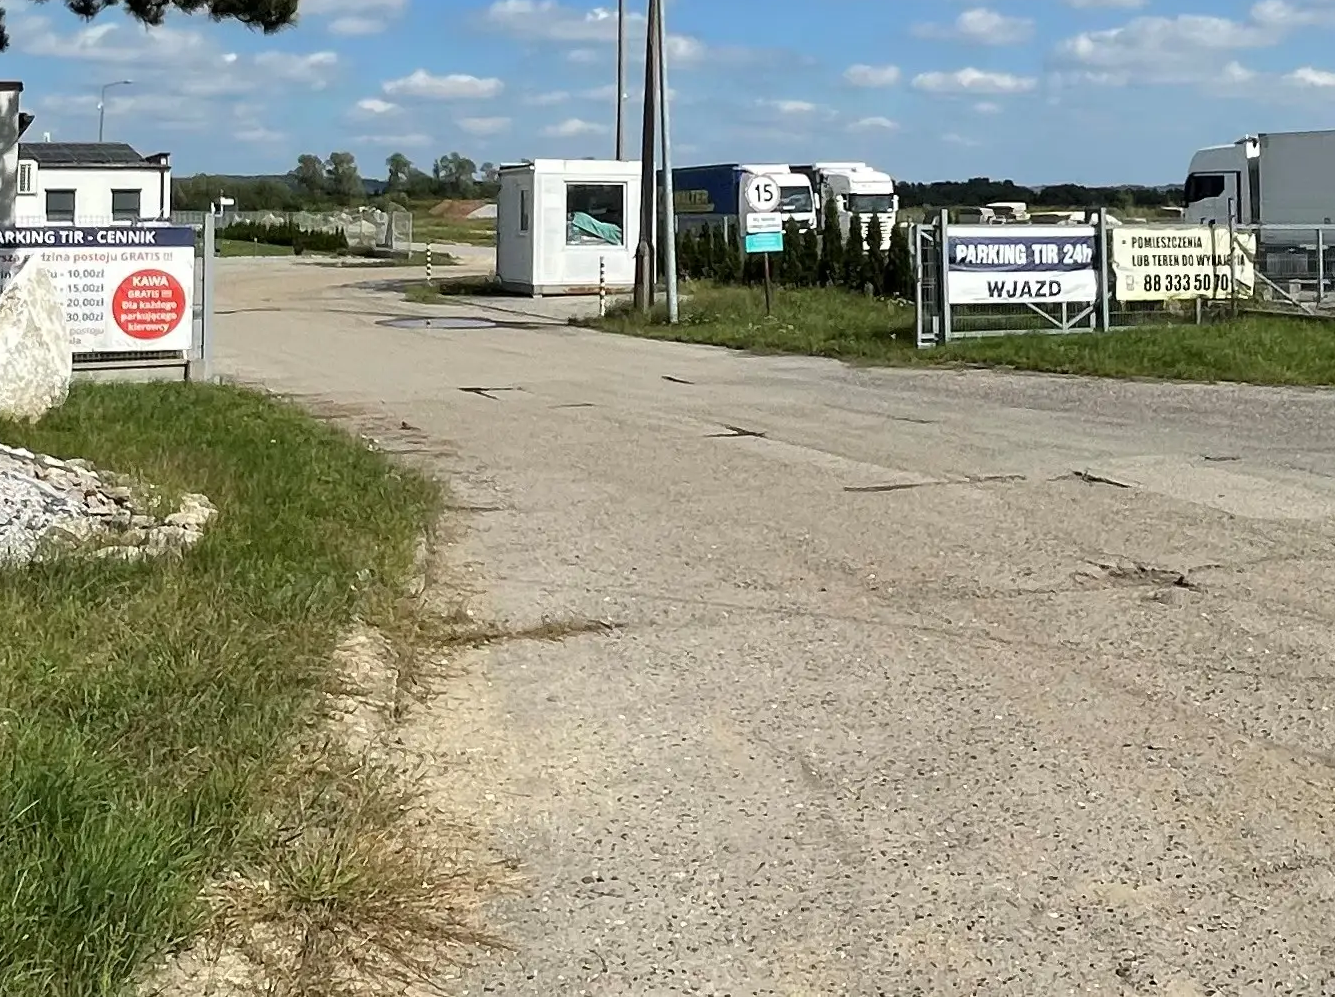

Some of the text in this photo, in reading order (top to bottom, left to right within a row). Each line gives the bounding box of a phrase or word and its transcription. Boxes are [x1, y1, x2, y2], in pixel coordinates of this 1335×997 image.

[754, 184, 773, 202] 15
[59, 230, 84, 244] TIR
[96, 230, 156, 244] CENNIK
[1131, 236, 1202, 249] POMIESZCZENIA
[73, 252, 117, 263] postoju
[121, 252, 160, 262] GRATIS
[956, 243, 1092, 264] PARKING TIR 24h
[1132, 254, 1150, 267] LUB
[1152, 254, 1180, 267] TEREN
[1182, 254, 1194, 267] DO
[133, 276, 169, 286] KAWA
[1144, 273, 1229, 291] 88 333 50 70
[128, 289, 159, 298] GRATIS
[987, 280, 1062, 298] WJAZD
